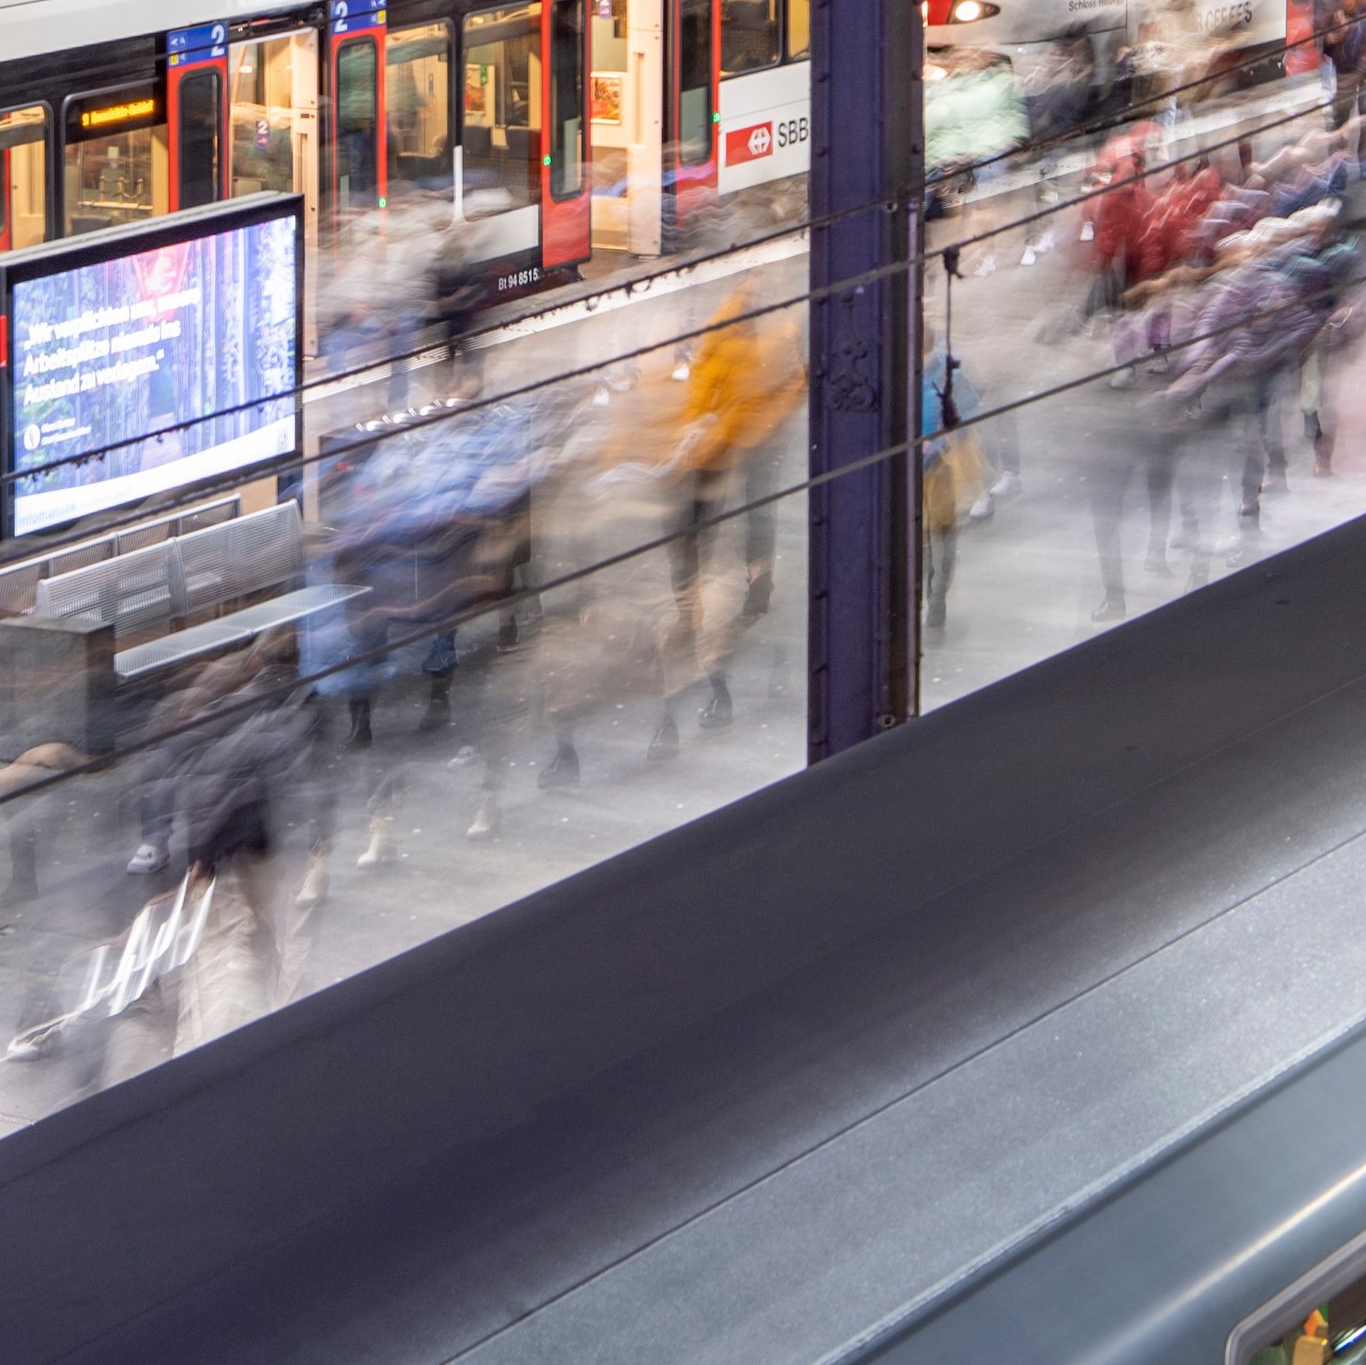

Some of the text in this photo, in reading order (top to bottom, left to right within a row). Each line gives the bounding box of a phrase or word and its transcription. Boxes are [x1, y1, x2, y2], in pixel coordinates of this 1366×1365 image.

[334, 1, 348, 33] 2
[210, 24, 225, 57] 2
[257, 120, 269, 134] 2
[777, 117, 809, 148] SBB
